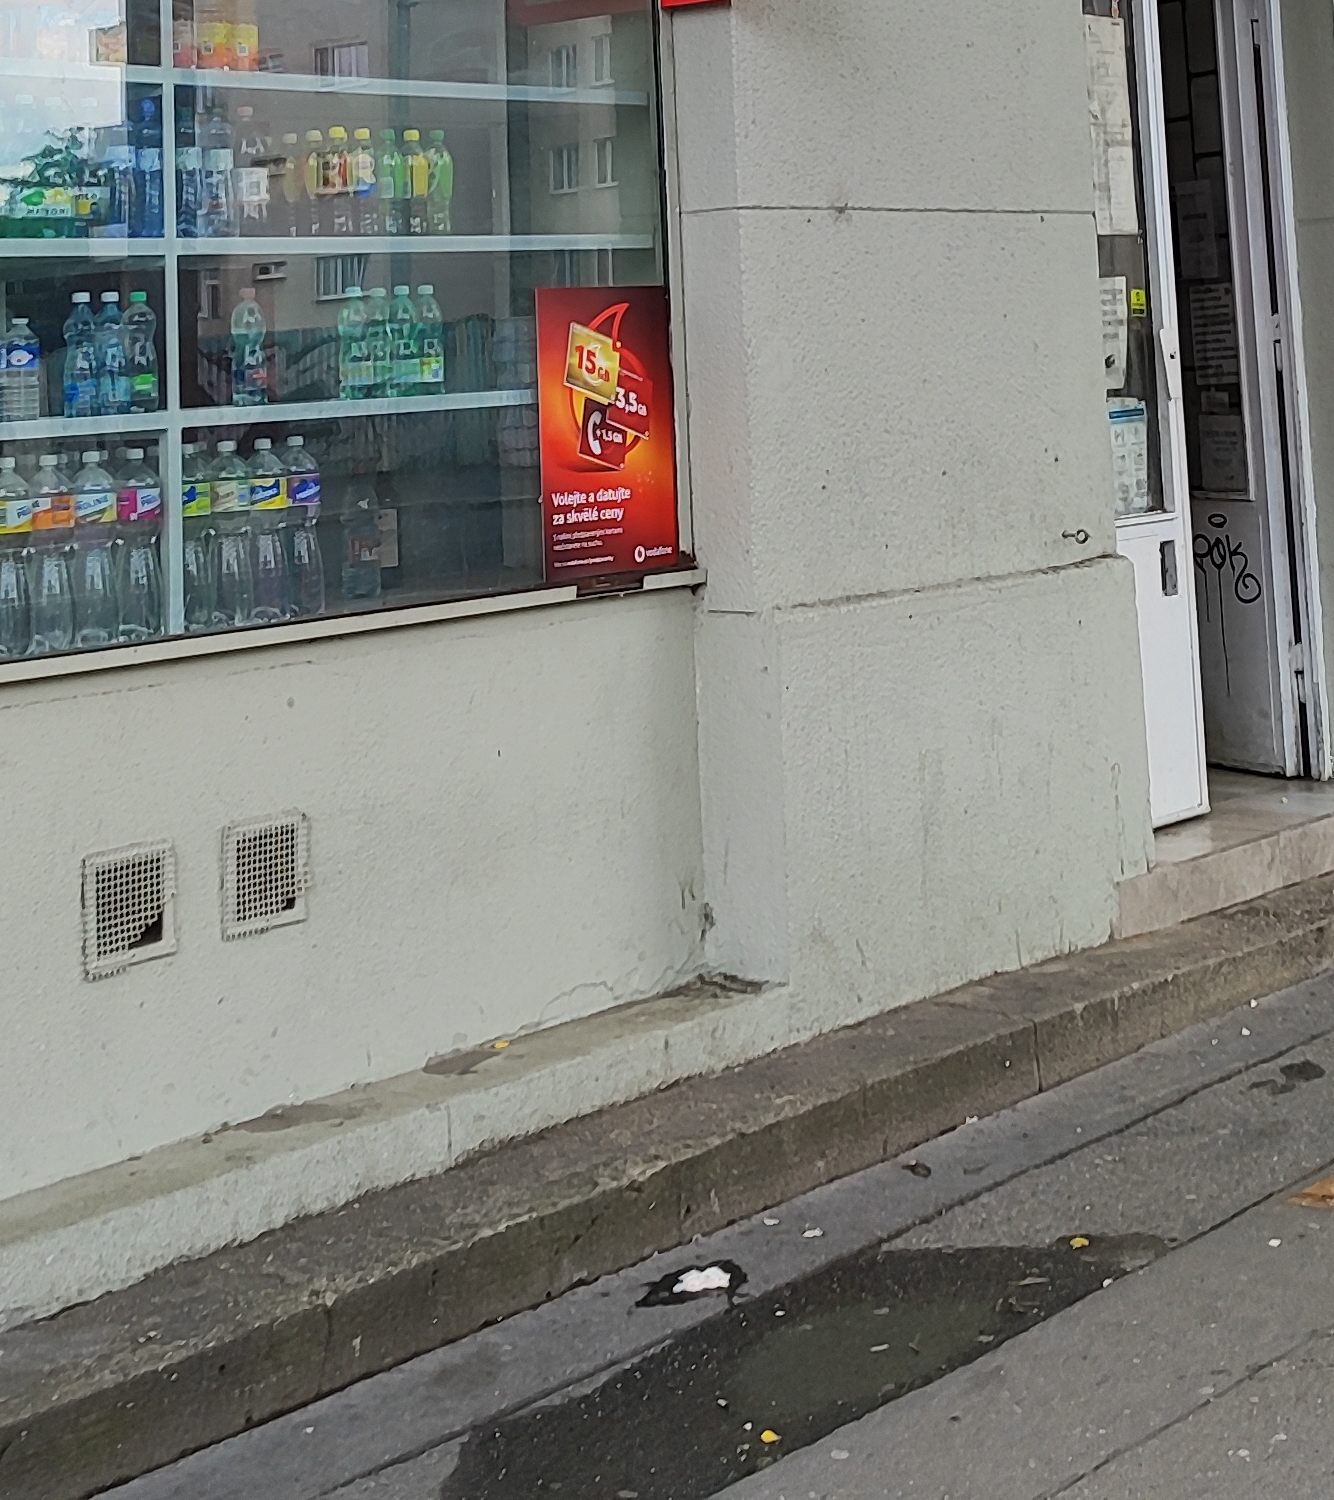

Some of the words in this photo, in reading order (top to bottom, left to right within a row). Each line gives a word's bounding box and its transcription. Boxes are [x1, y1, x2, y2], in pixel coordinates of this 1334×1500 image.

[574, 344, 596, 374] 15
[551, 491, 587, 507] Volejte
[588, 492, 595, 503] a
[596, 487, 631, 503] datujte
[552, 513, 565, 525] za
[566, 506, 599, 524] skvělé
[599, 507, 624, 521] ceny
